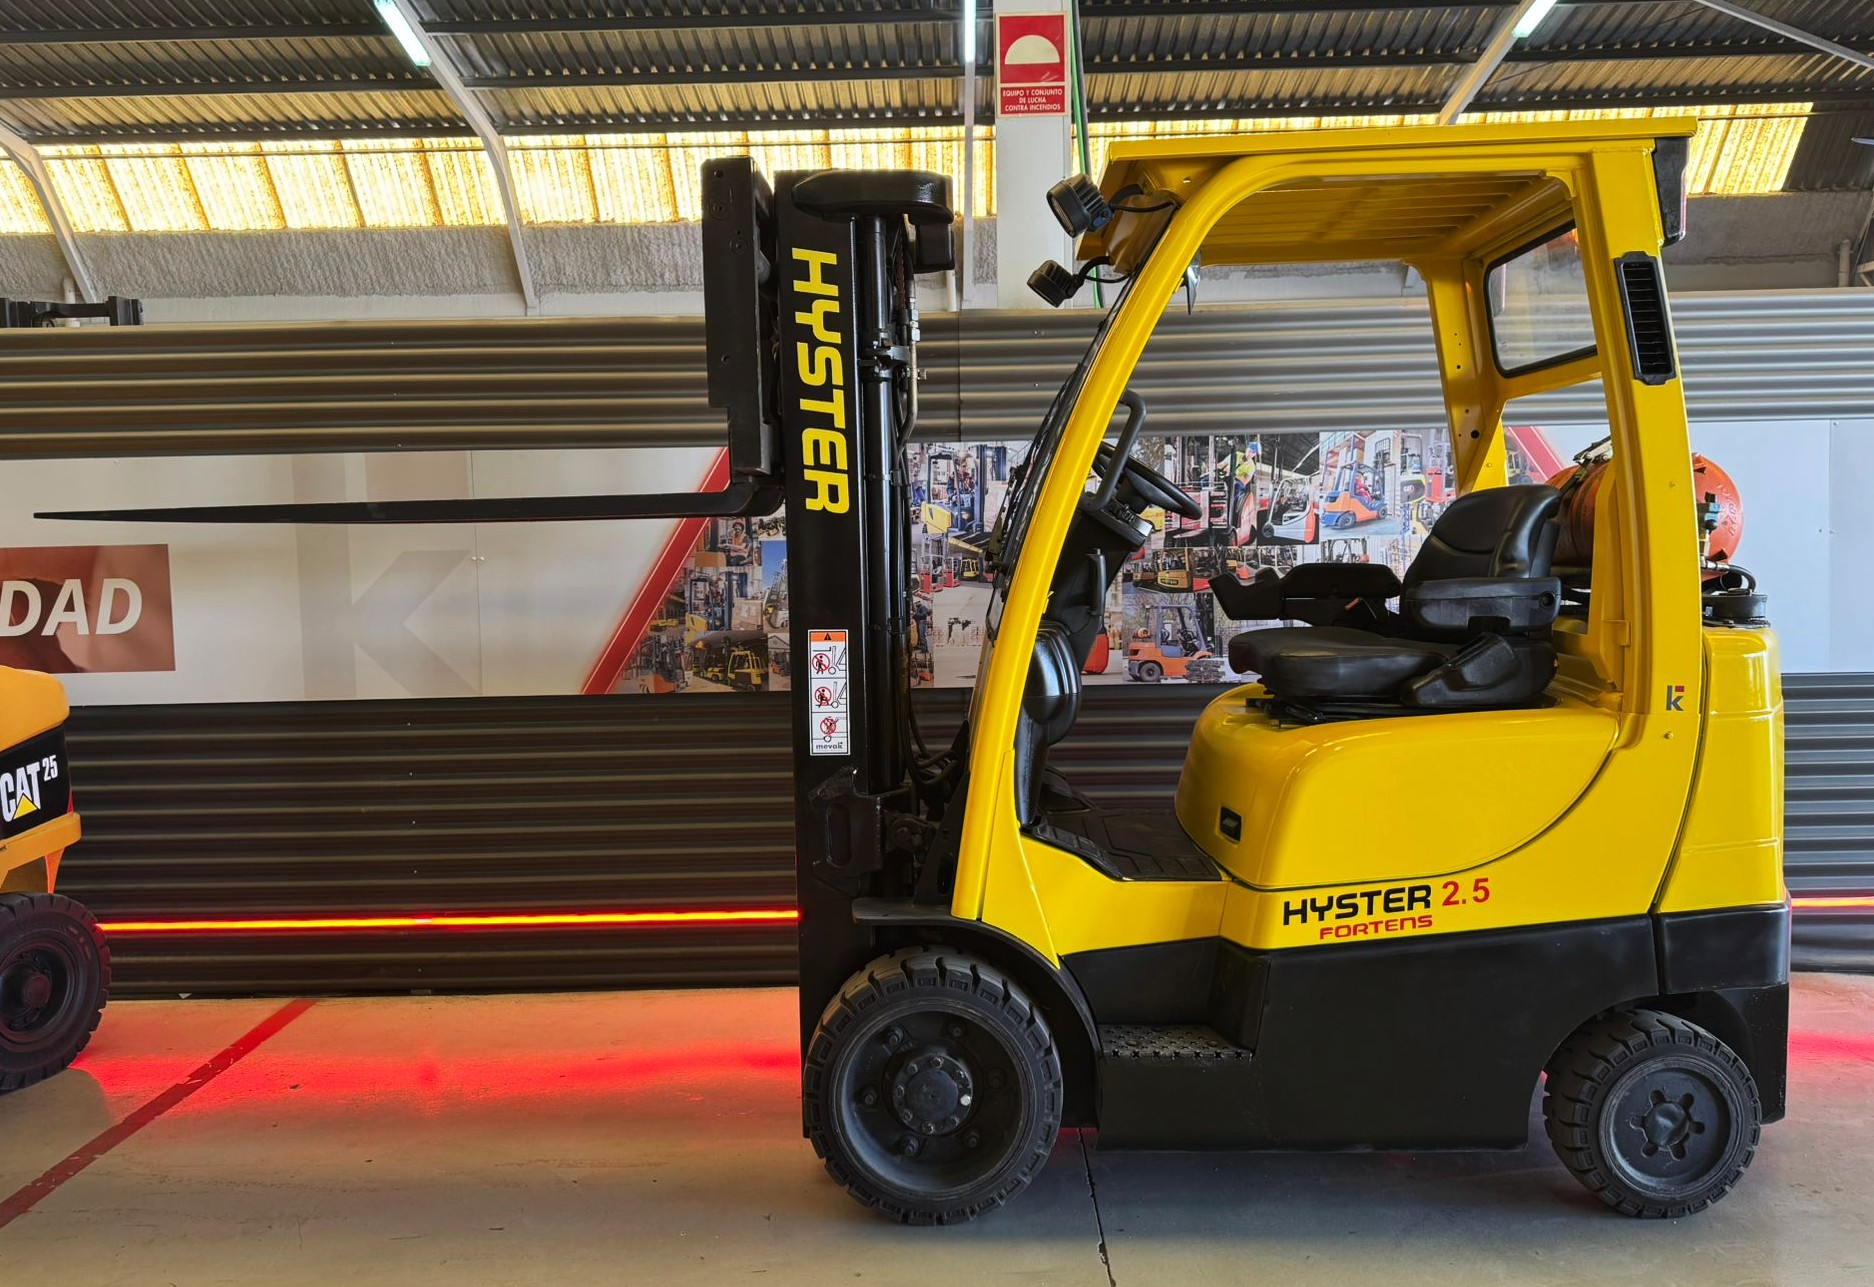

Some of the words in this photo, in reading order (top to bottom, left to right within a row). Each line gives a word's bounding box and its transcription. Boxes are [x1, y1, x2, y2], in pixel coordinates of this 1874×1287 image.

[1003, 89, 1024, 97] EQUIPO
[1031, 88, 1063, 96] CONJUNTO
[1004, 104, 1028, 112] CONTRA
[1029, 103, 1061, 111] INCENDIOS
[792, 247, 850, 514] HYSTER
[0, 578, 142, 637] DAD
[0, 762, 41, 822] CAT
[42, 755, 58, 782] 25
[1283, 884, 1432, 926] HYSTER
[1442, 877, 1490, 907] 2.5
[1319, 914, 1433, 940] FORTENS
